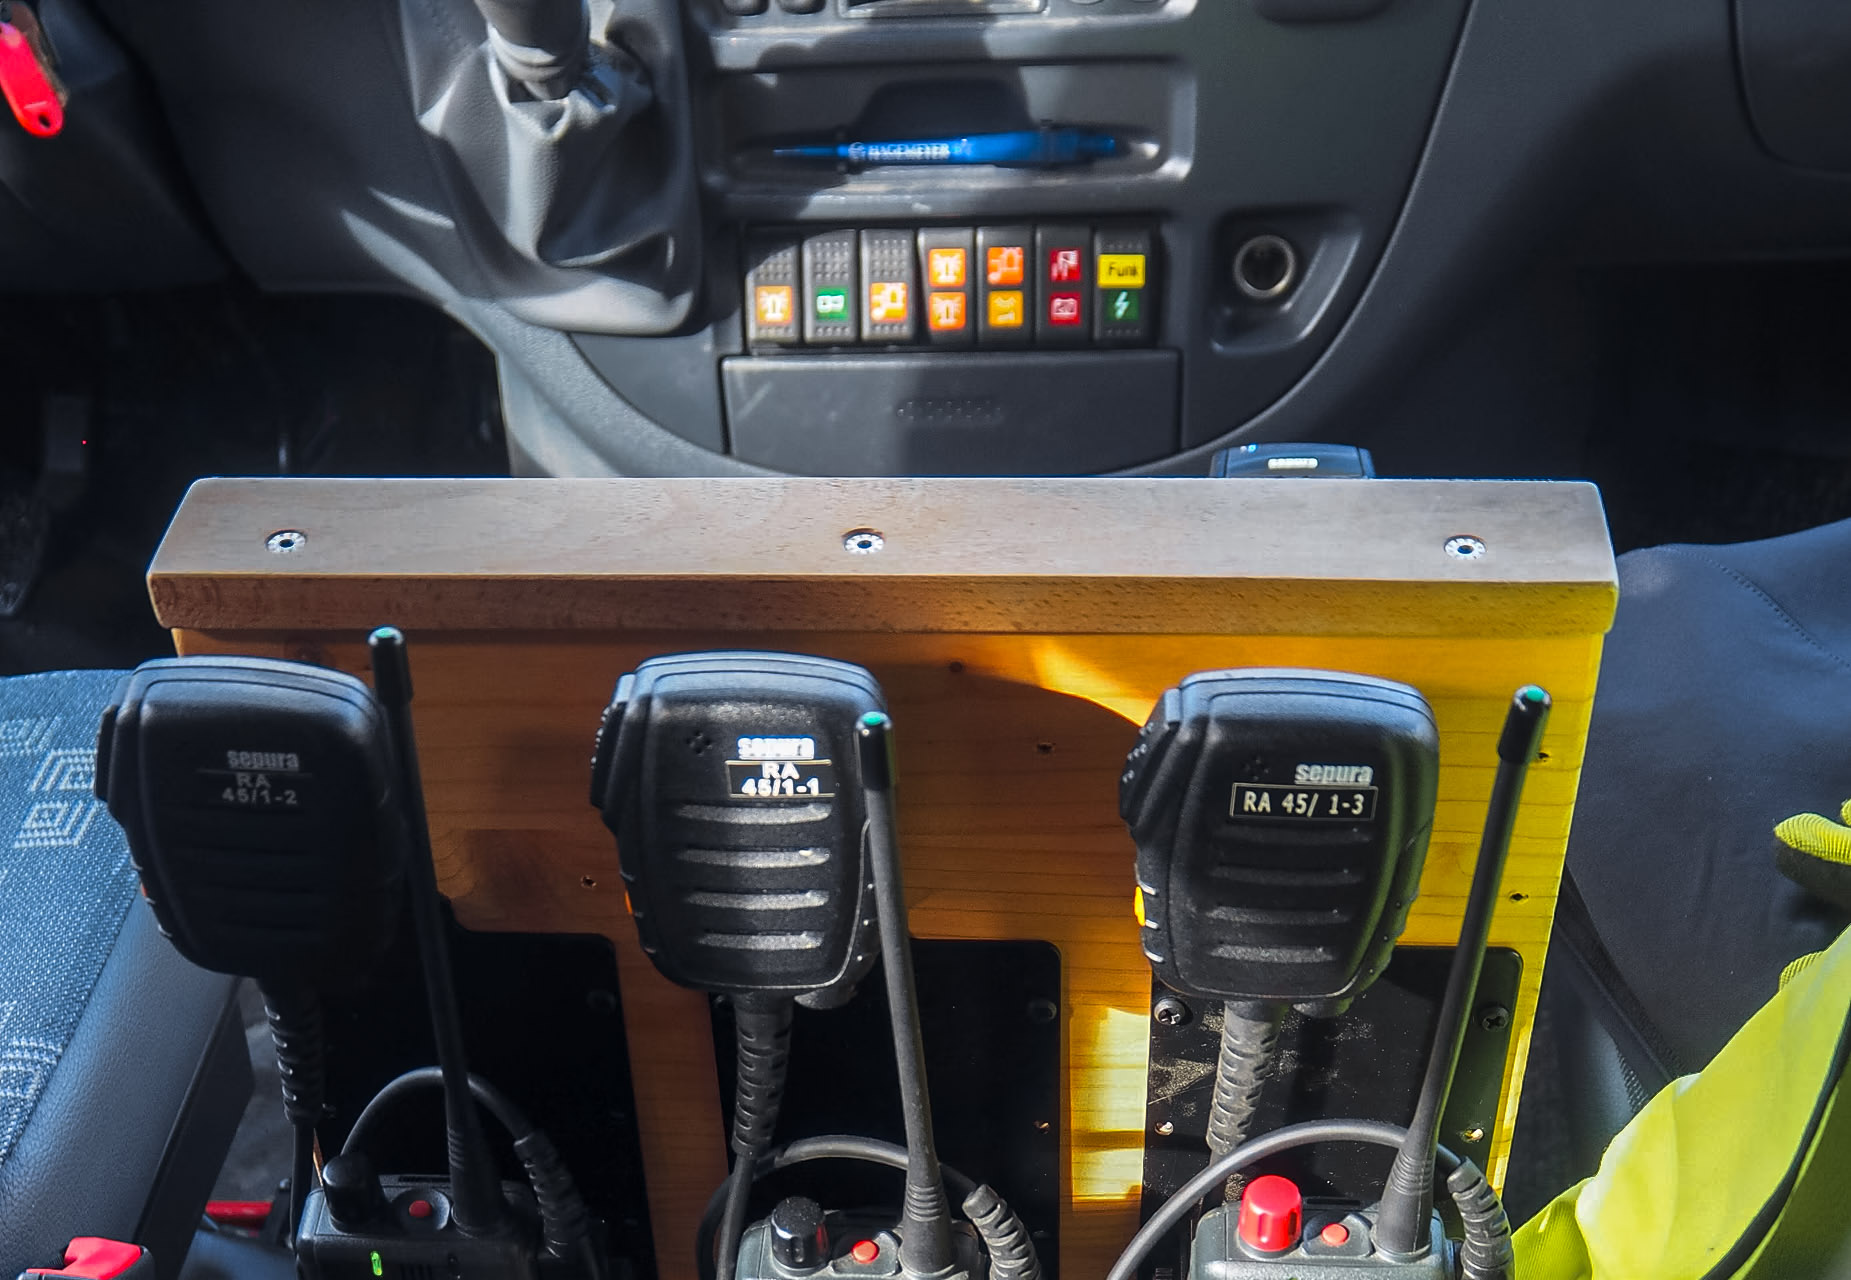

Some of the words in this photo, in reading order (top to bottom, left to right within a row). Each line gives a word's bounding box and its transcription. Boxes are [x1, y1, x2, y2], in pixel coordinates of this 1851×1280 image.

[1108, 261, 1138, 277] Funk
[236, 772, 272, 788] RA
[762, 762, 800, 780] RA
[1294, 764, 1374, 786] sepura
[221, 787, 298, 805] 45/1-2
[741, 778, 819, 797] 45/1-1
[1243, 791, 1271, 813] RA
[1328, 794, 1365, 815] 1-3
